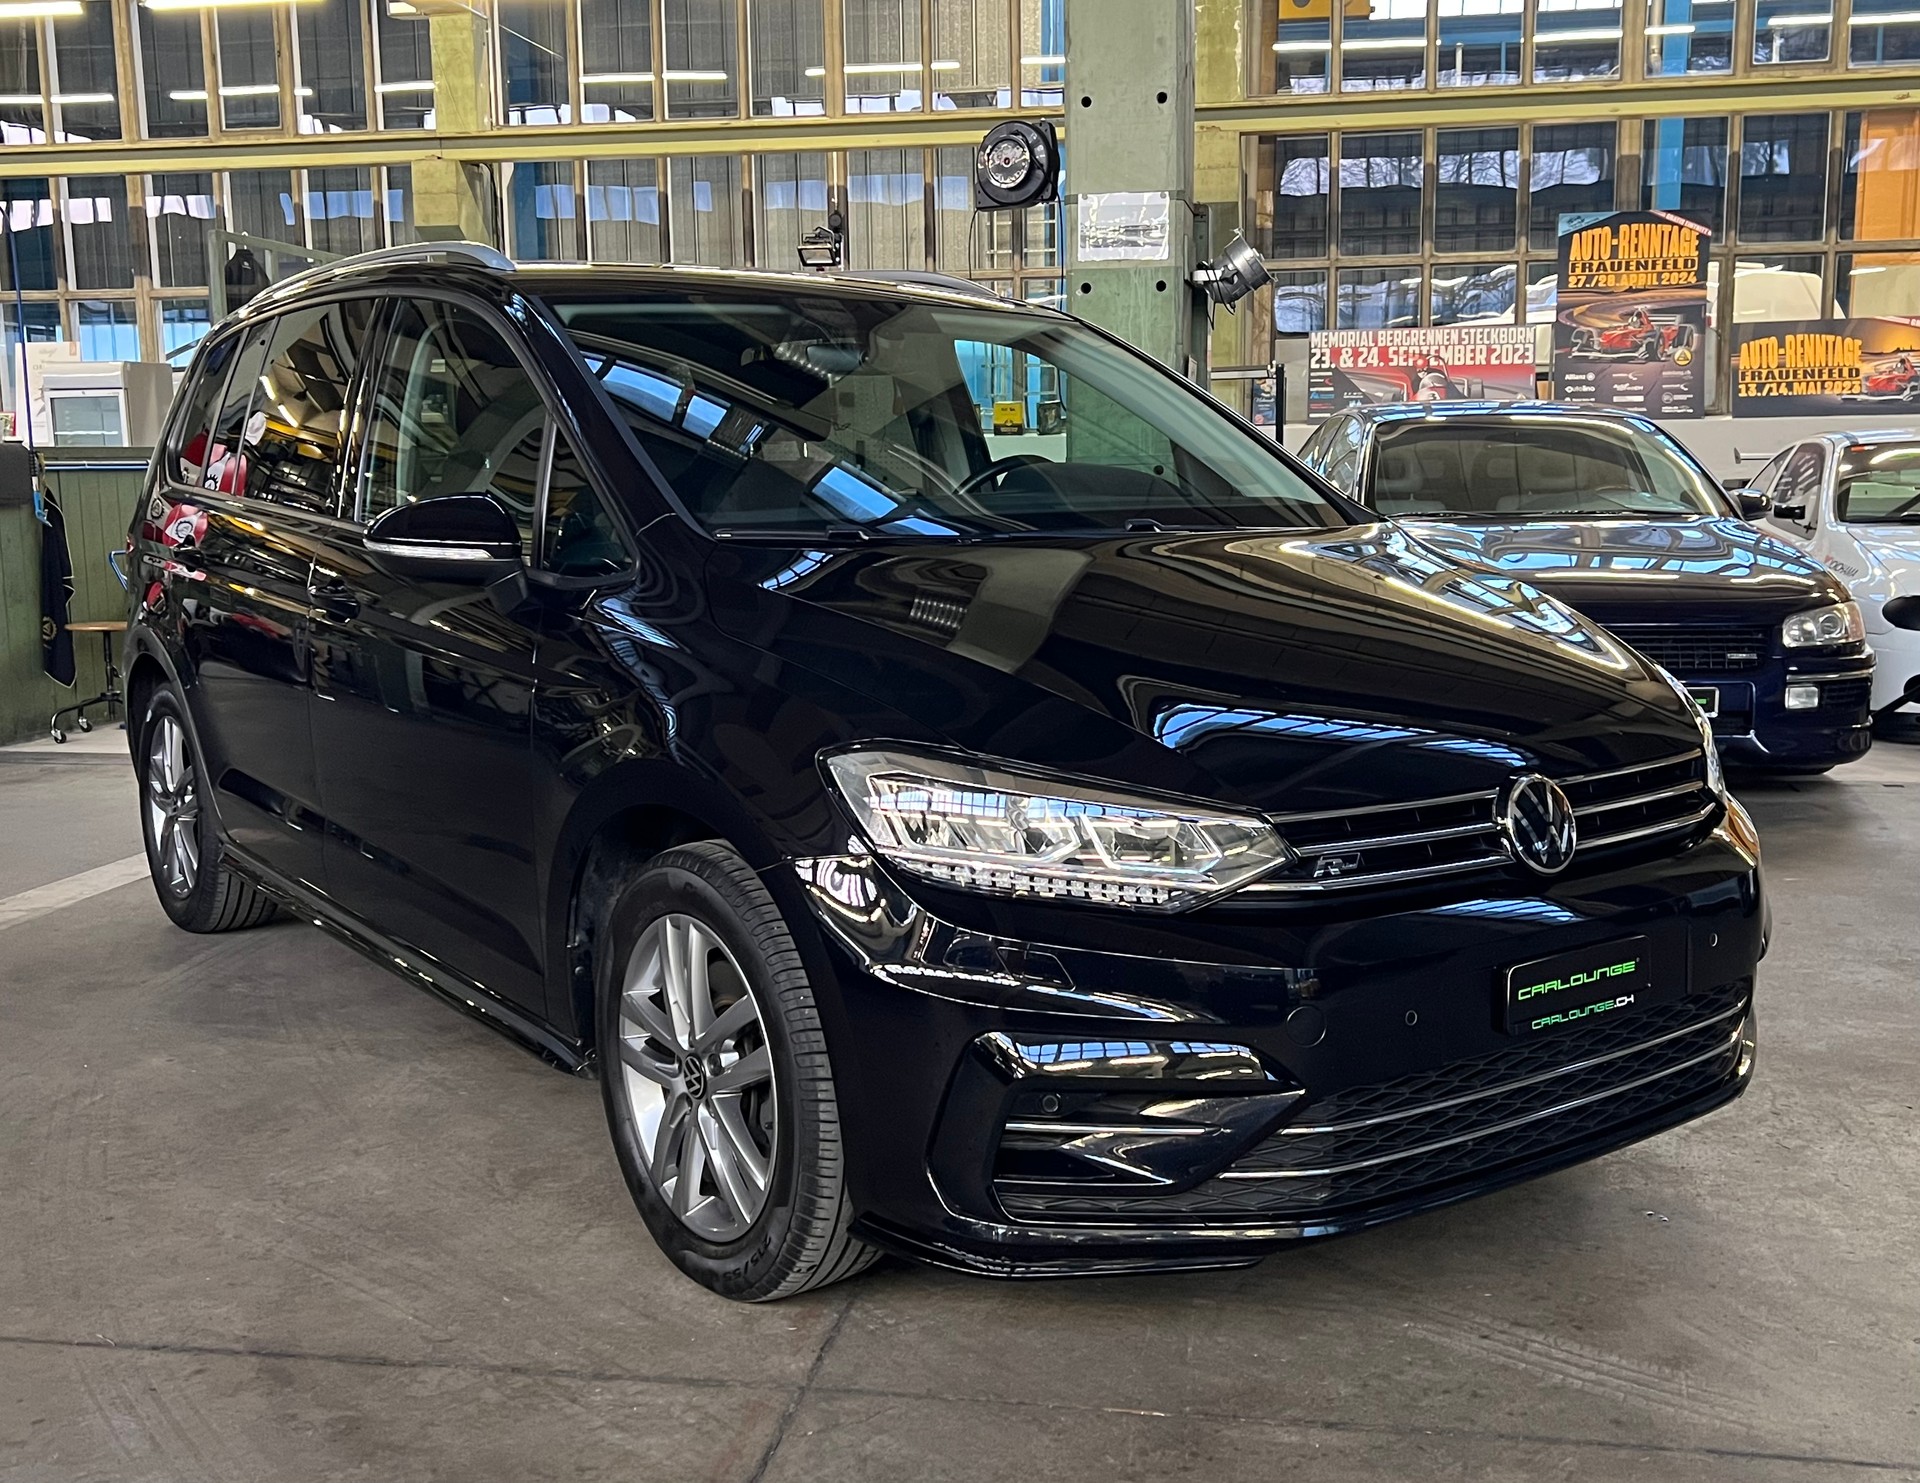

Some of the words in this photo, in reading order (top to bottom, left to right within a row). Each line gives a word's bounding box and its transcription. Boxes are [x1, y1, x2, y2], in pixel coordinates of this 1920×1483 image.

[1569, 223, 1700, 261] AUTO-RENNTAGE
[1570, 258, 1697, 274] FRAUENFELD
[1660, 272, 1698, 286] 2024
[1310, 330, 1375, 349] MEMORIAL
[1378, 328, 1459, 347] BERGRENNEN
[1462, 327, 1535, 345] STECKBORN
[1310, 348, 1336, 369] 23.
[1339, 347, 1354, 368] &
[1358, 346, 1384, 368] 24.
[1490, 343, 1534, 365] 2023
[1739, 333, 1863, 370] AUTO-RENNTAGE
[1740, 367, 1861, 381] FRAUENFELD
[1824, 380, 1862, 395] 2023
[1518, 961, 1636, 1001] CARLOUNGE
[1531, 994, 1635, 1030] CARLOUNGE.CH
